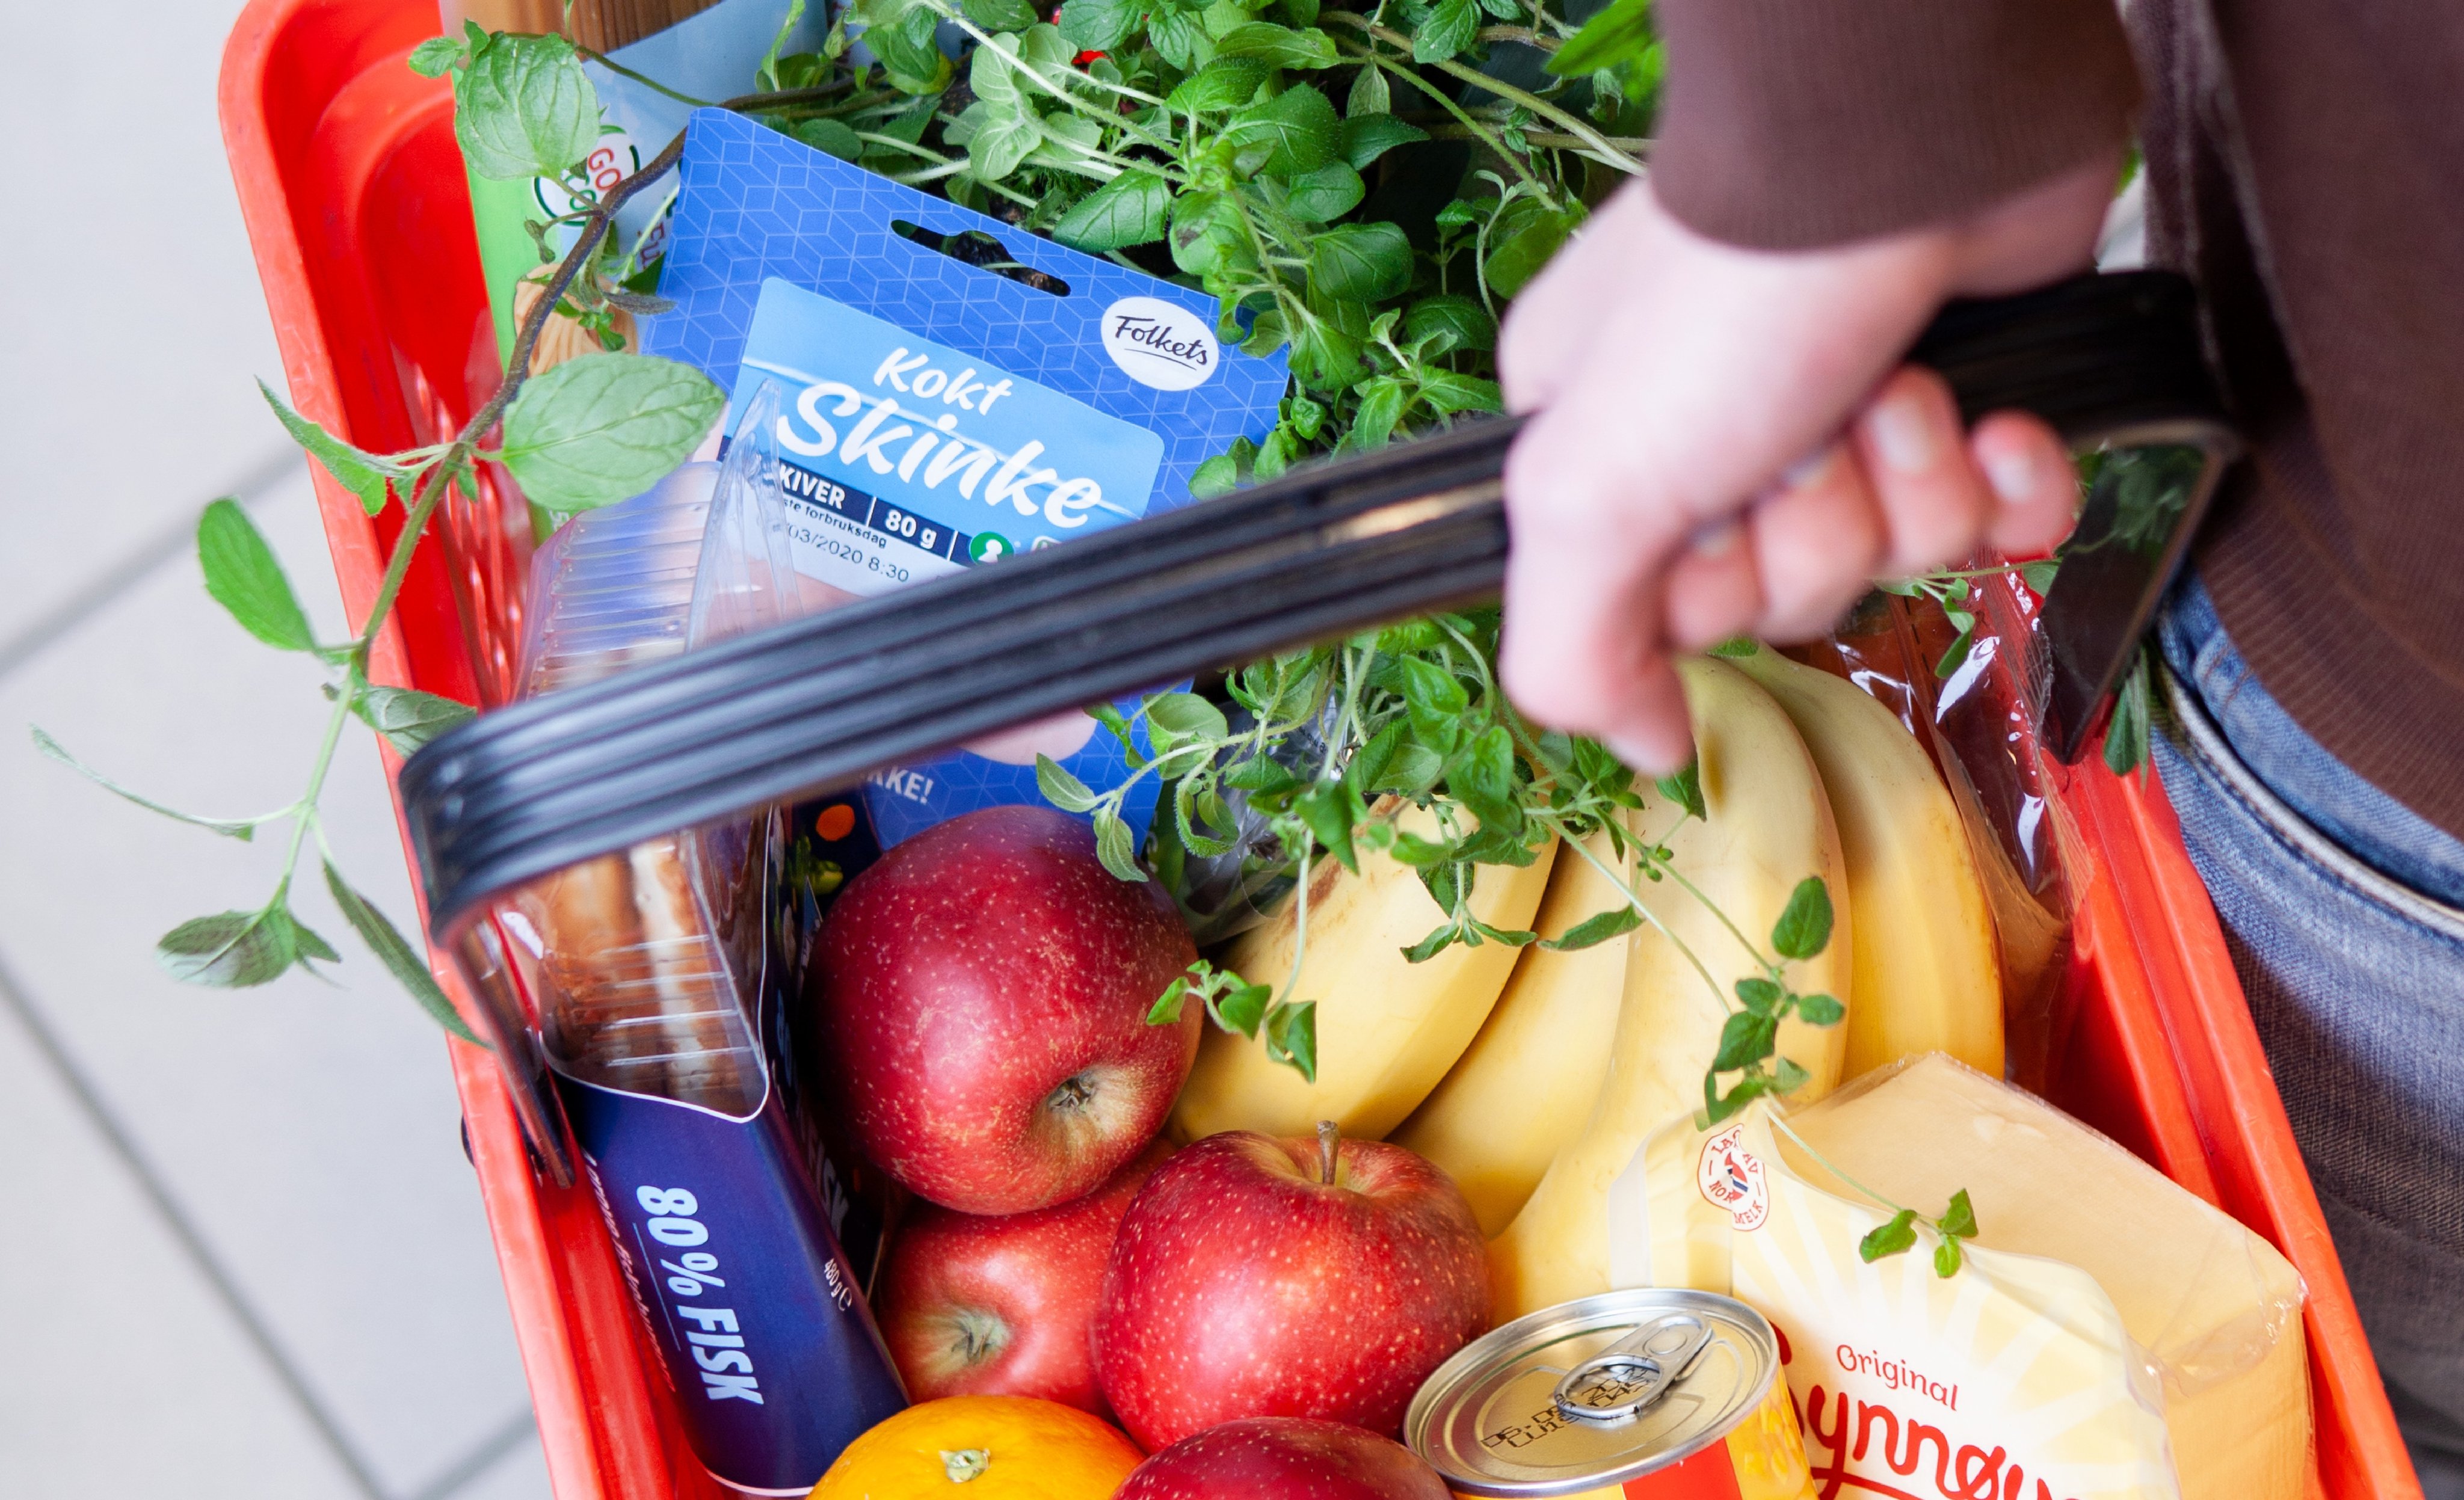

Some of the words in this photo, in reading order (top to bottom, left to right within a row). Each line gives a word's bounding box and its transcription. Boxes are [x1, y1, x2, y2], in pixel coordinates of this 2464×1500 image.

[1115, 315, 1208, 366] Folkets
[873, 346, 1013, 416] Kokt
[777, 382, 1103, 529] Skinke
[778, 464, 846, 510] KIVER
[885, 509, 917, 538] 80
[920, 527, 937, 550] g
[783, 497, 801, 511] ste
[805, 505, 887, 549] forbruksdag
[786, 521, 863, 564] 03/2020
[867, 557, 910, 583] 8:30
[636, 1185, 726, 1297] 80%
[1733, 1199, 1763, 1225] MELK
[824, 1258, 840, 1286] 480
[677, 1305, 765, 1405] FISK
[1836, 1344, 1959, 1411] Original
[1769, 1320, 2083, 1500] ynnø
